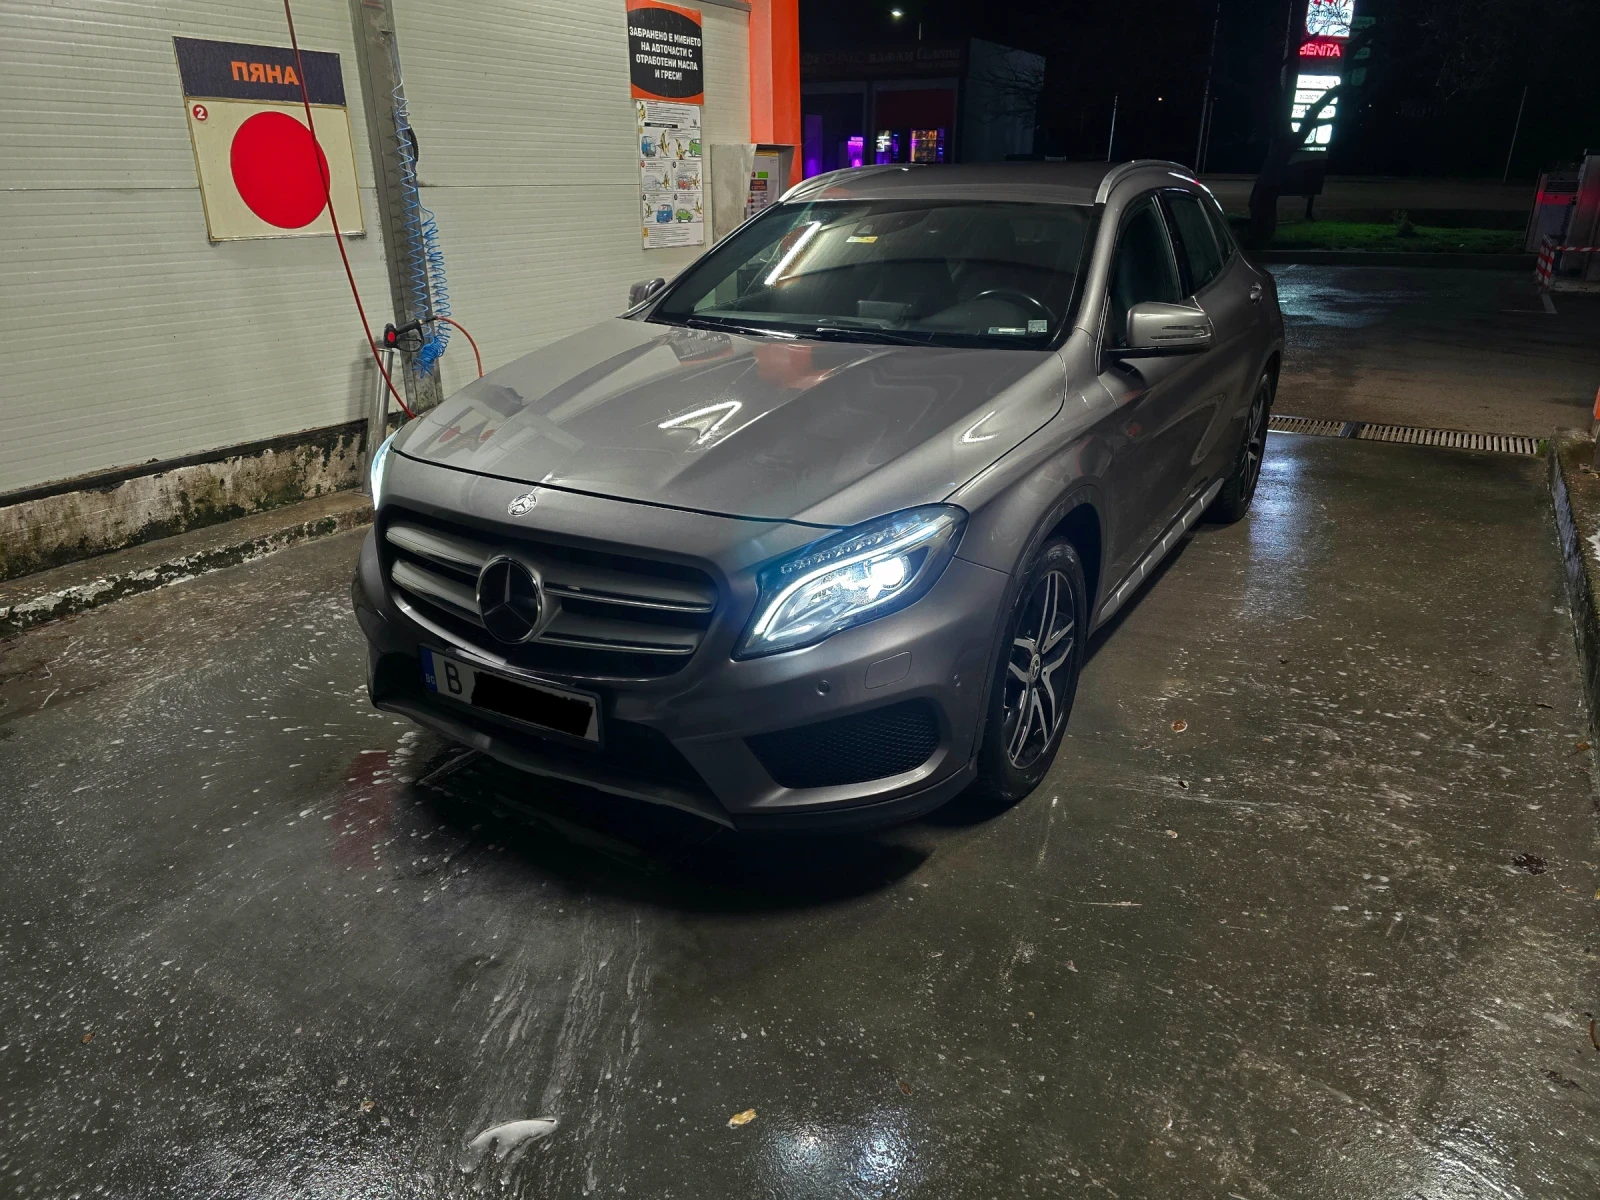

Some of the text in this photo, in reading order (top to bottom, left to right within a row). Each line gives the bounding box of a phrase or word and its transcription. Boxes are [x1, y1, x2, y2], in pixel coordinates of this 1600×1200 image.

[629, 26, 701, 47] ЗАБРАНЕНО Е МИЕНЕТО
[641, 41, 692, 57] НА АВТОЧАСТИ С
[636, 54, 698, 71] ОТРАБОТЕНИ МАСЛА
[231, 61, 300, 85] ПЯНА
[654, 69, 660, 78] И
[195, 107, 205, 119] 2
[425, 674, 435, 685] BG
[444, 661, 462, 695] B
